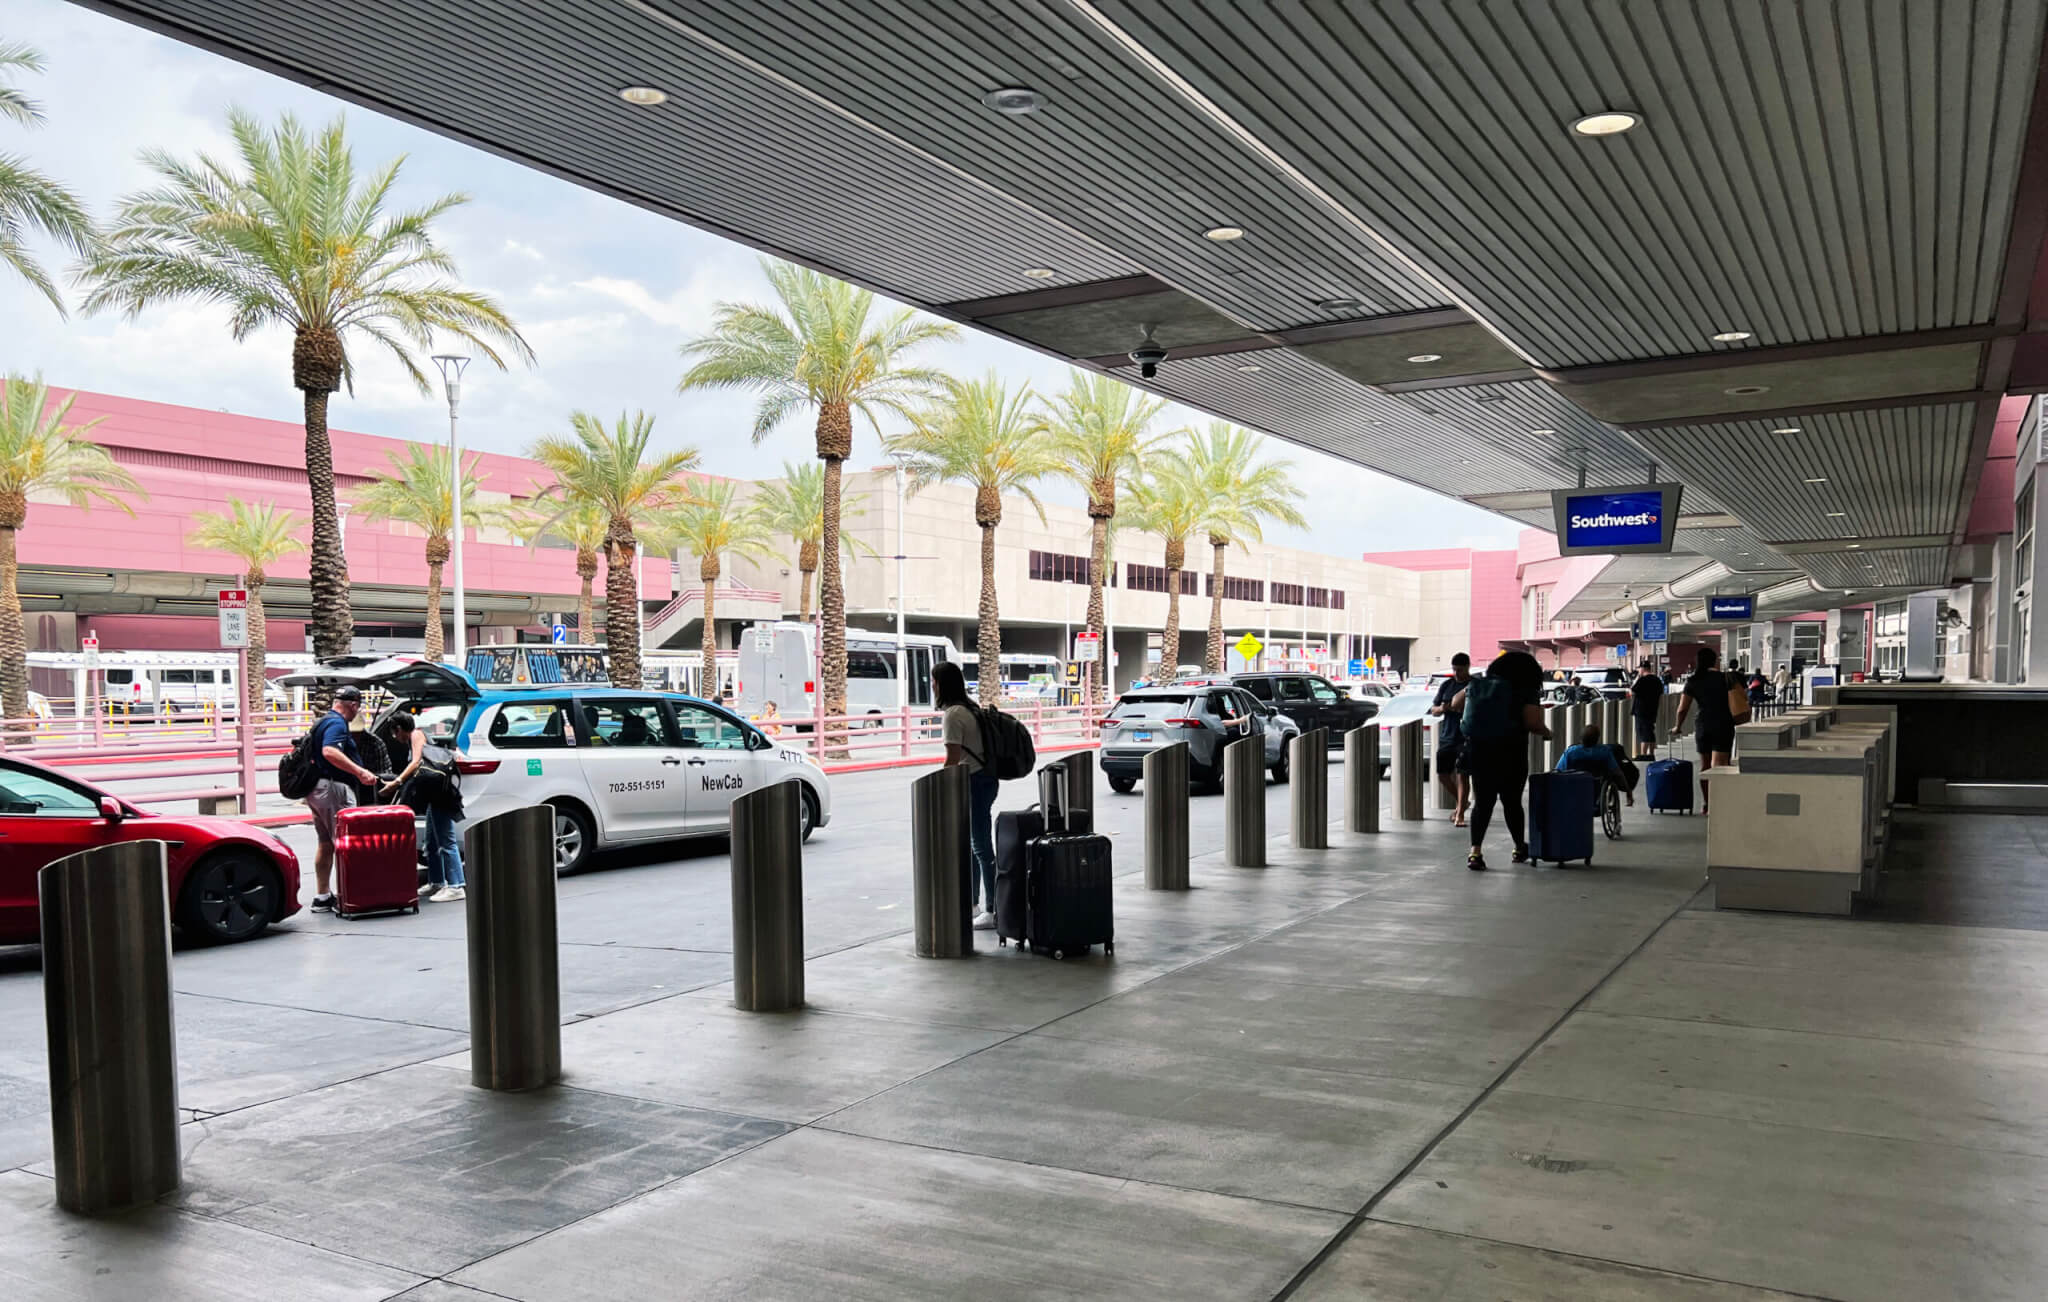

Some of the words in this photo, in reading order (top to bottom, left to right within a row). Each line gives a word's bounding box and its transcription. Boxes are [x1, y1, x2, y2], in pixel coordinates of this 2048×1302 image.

[1571, 512, 1649, 528] Southwest
[228, 592, 237, 600] NO
[220, 600, 246, 608] STOPPING
[226, 612, 240, 621] THRU
[227, 622, 240, 631] LANE
[227, 632, 240, 641] ONLY
[555, 627, 565, 645] 2
[528, 655, 563, 683] FATOR
[609, 780, 665, 793] 702-551-5151
[702, 773, 743, 791] NewCab
